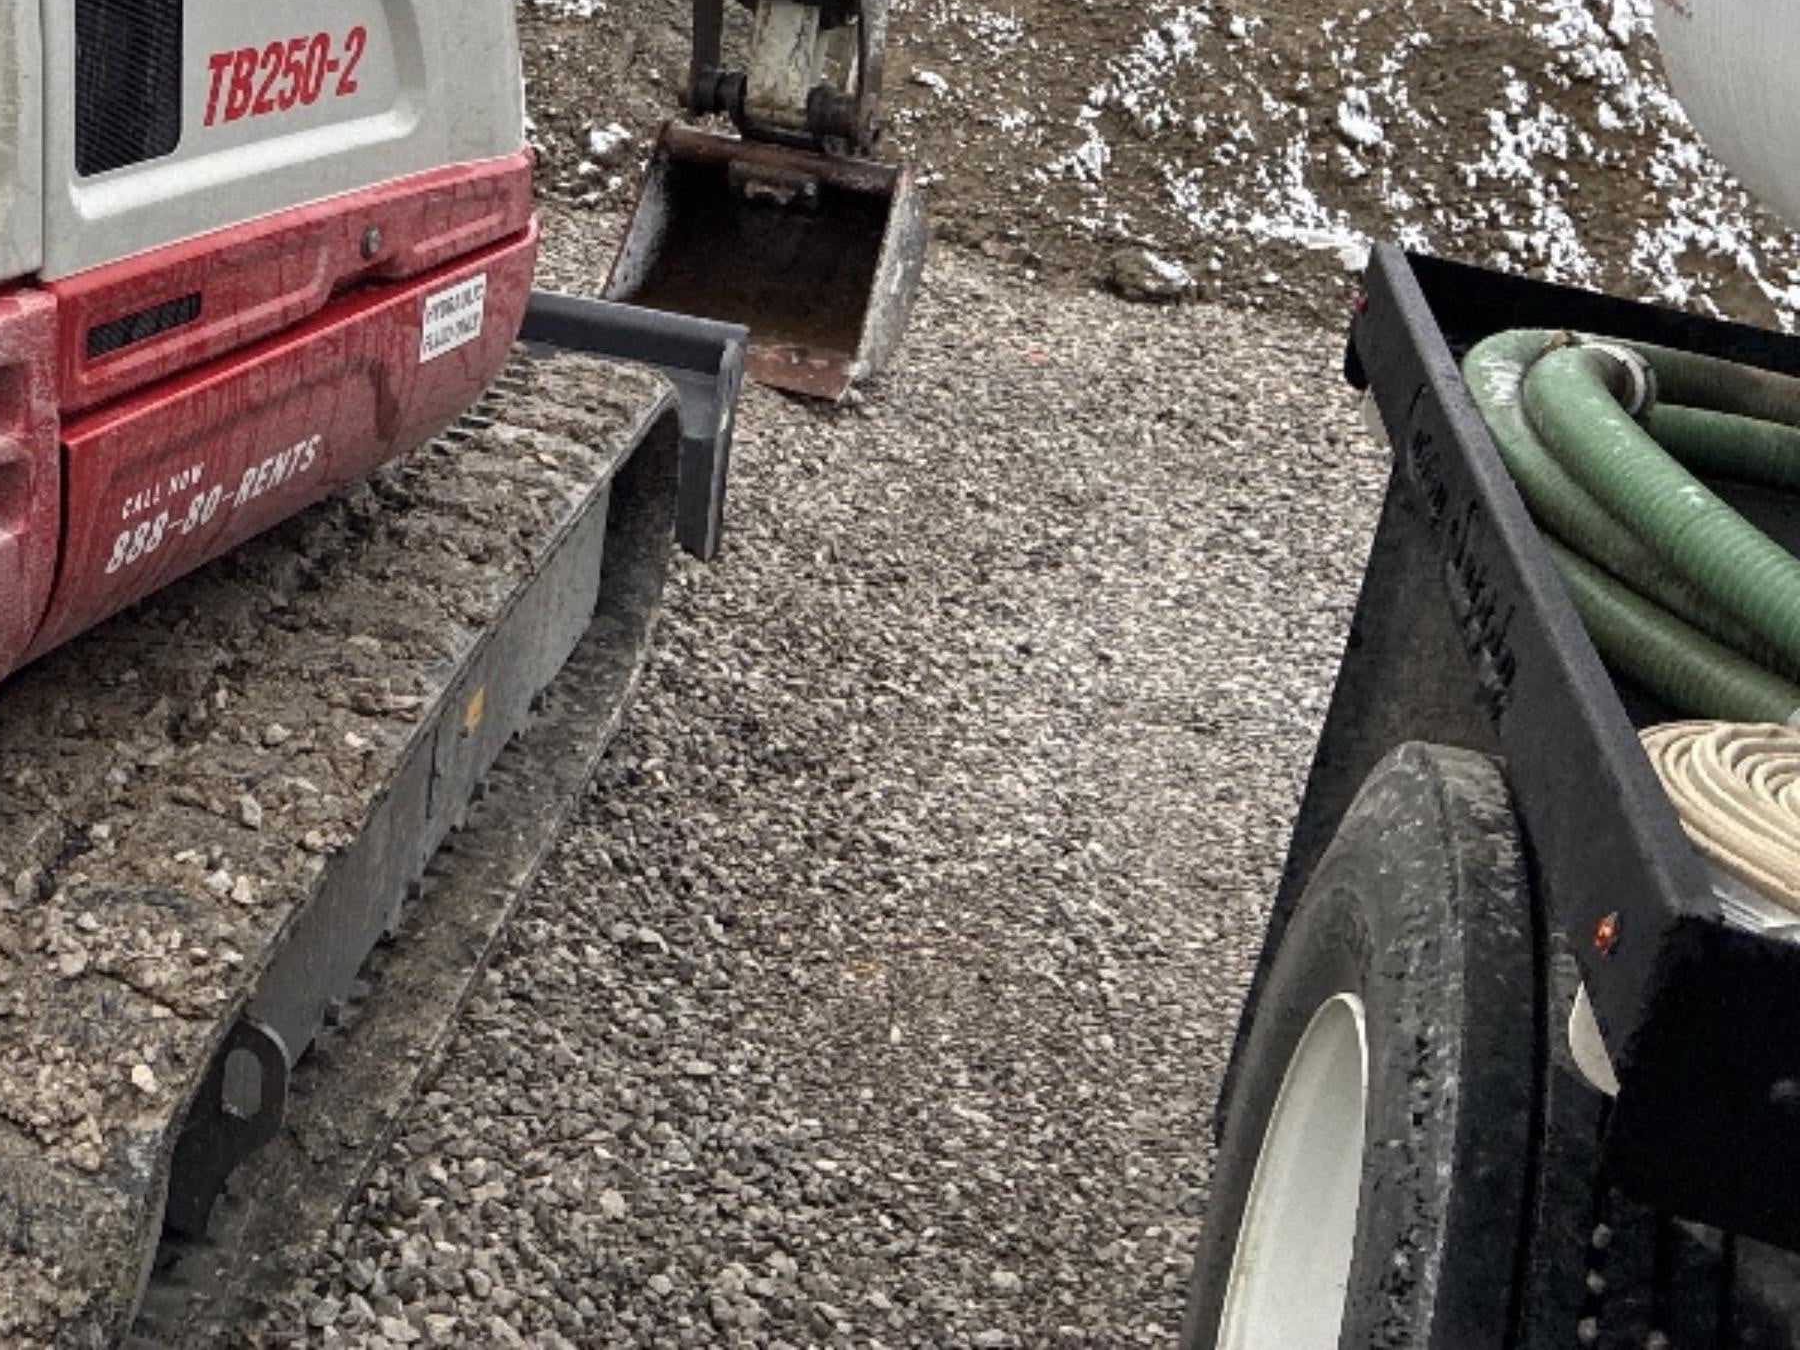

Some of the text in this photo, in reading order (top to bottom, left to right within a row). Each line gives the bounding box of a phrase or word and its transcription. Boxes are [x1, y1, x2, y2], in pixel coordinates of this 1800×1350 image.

[203, 25, 367, 127] TB250-2
[122, 462, 205, 520] CALL NOW
